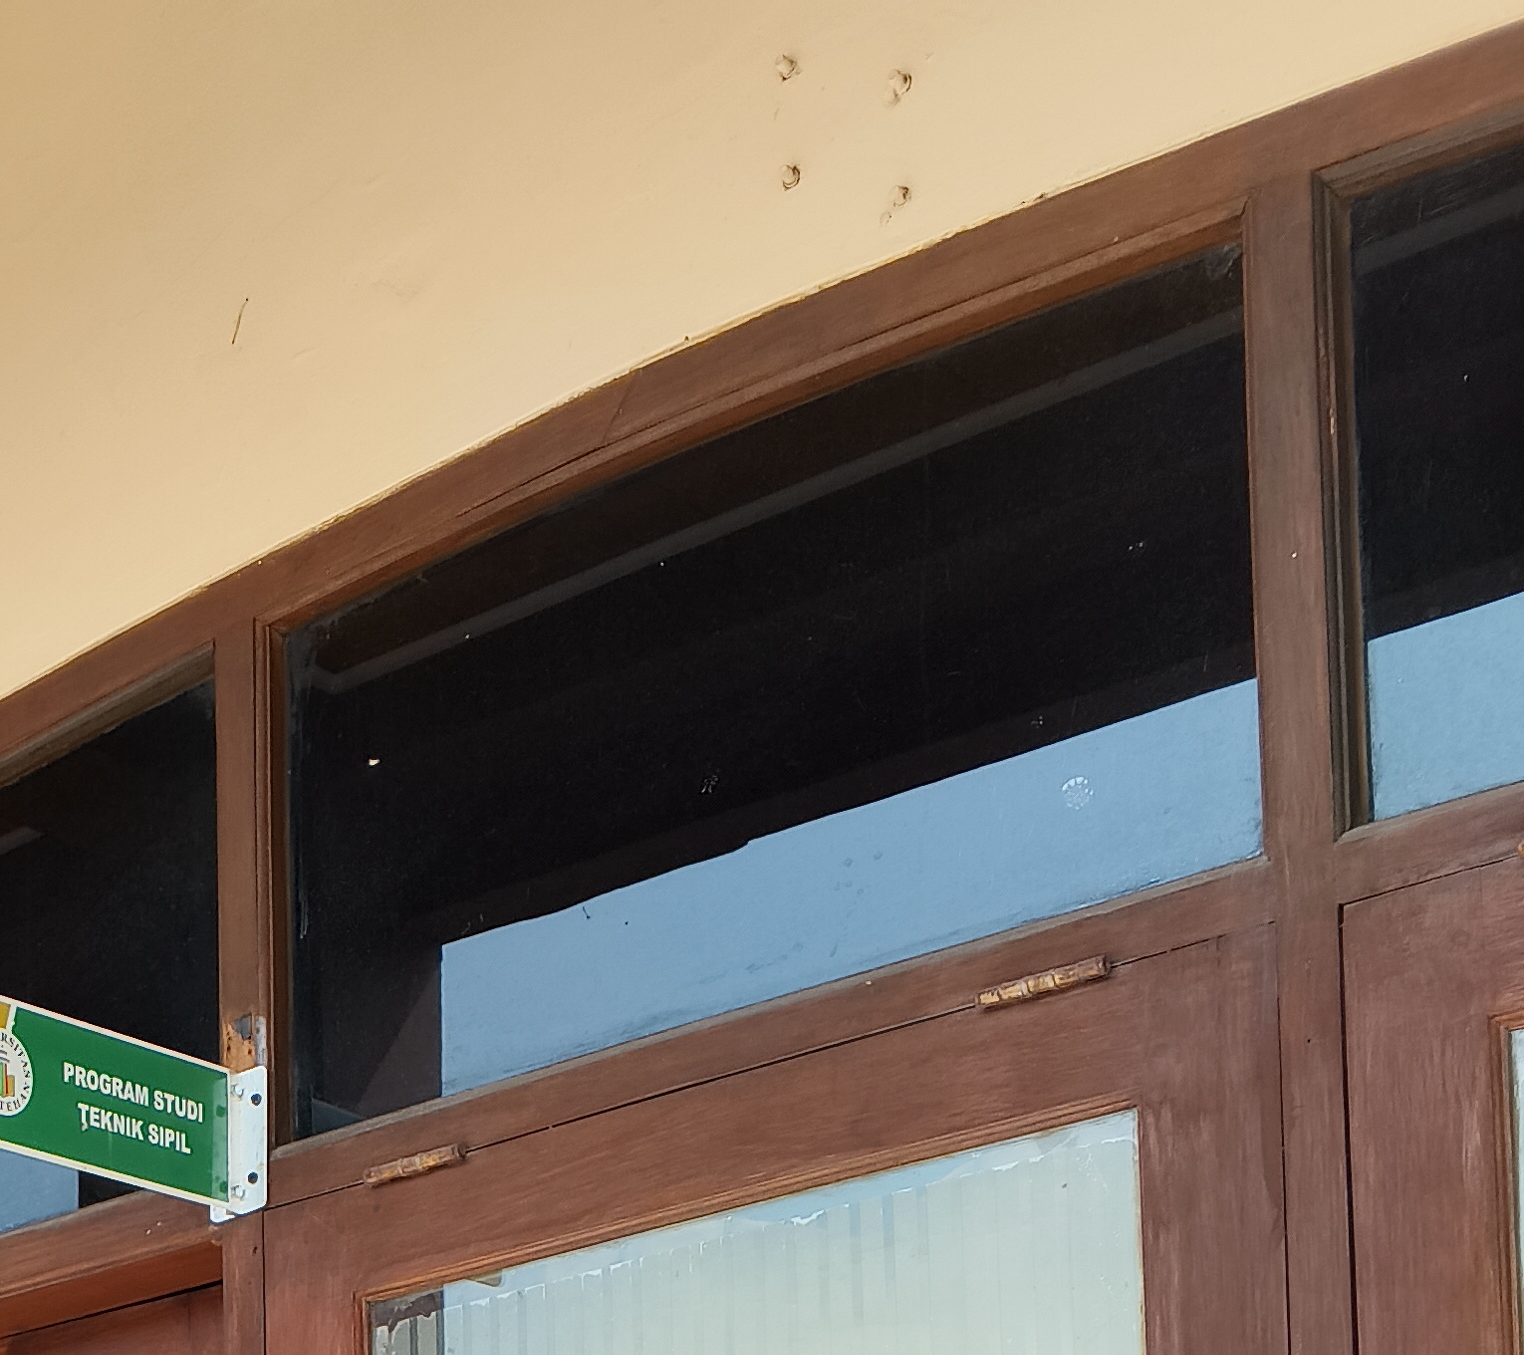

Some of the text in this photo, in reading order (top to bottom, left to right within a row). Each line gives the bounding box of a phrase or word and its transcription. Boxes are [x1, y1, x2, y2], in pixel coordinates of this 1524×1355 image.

[62, 1061, 204, 1124] PROGRAM STUDI
[77, 1102, 192, 1155] TEKNIK SIPIL
